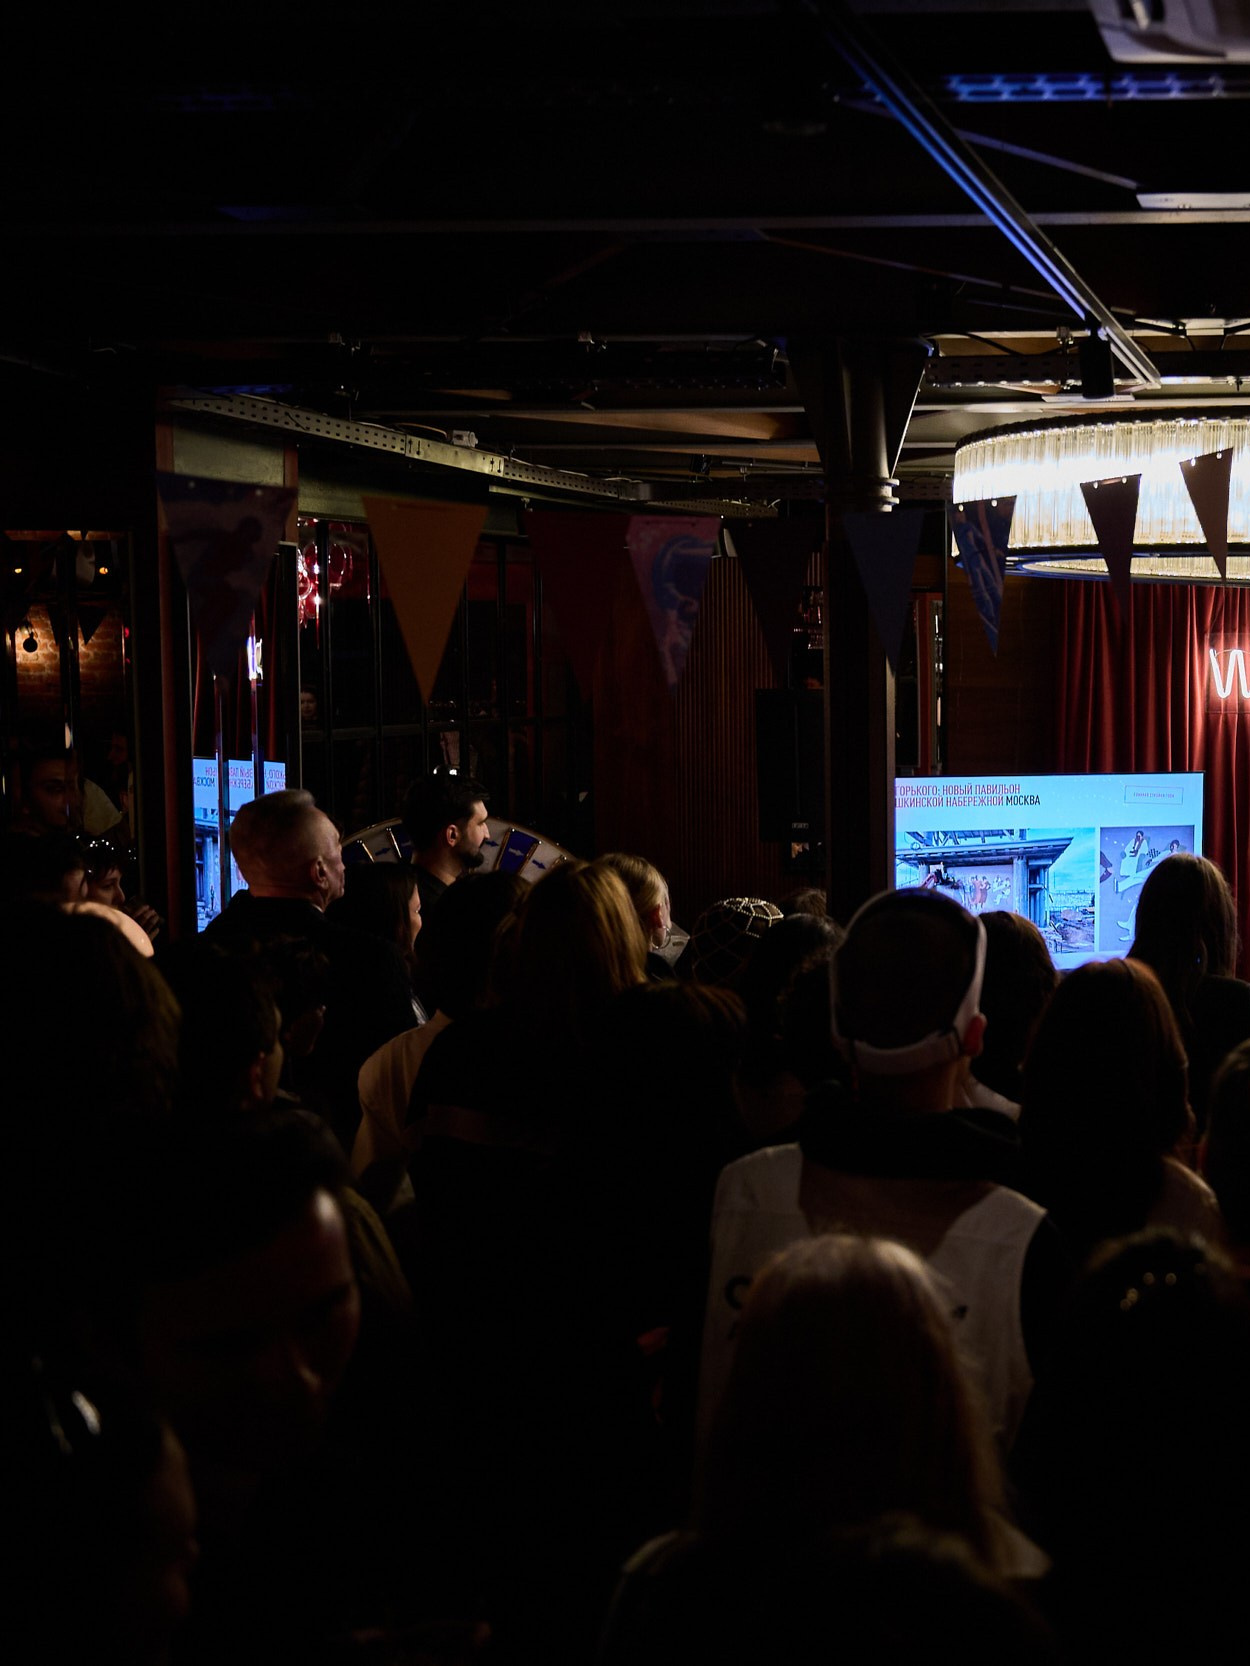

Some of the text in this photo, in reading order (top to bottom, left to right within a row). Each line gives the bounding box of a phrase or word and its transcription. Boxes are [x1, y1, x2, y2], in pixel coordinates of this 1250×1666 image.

[942, 783, 972, 795] НОВЫЙ
[975, 783, 1020, 795] ПАВИЛЬОН
[946, 794, 1004, 807] НАБЕРЕЖНОЙ
[1006, 794, 1040, 806] МОСКВА
